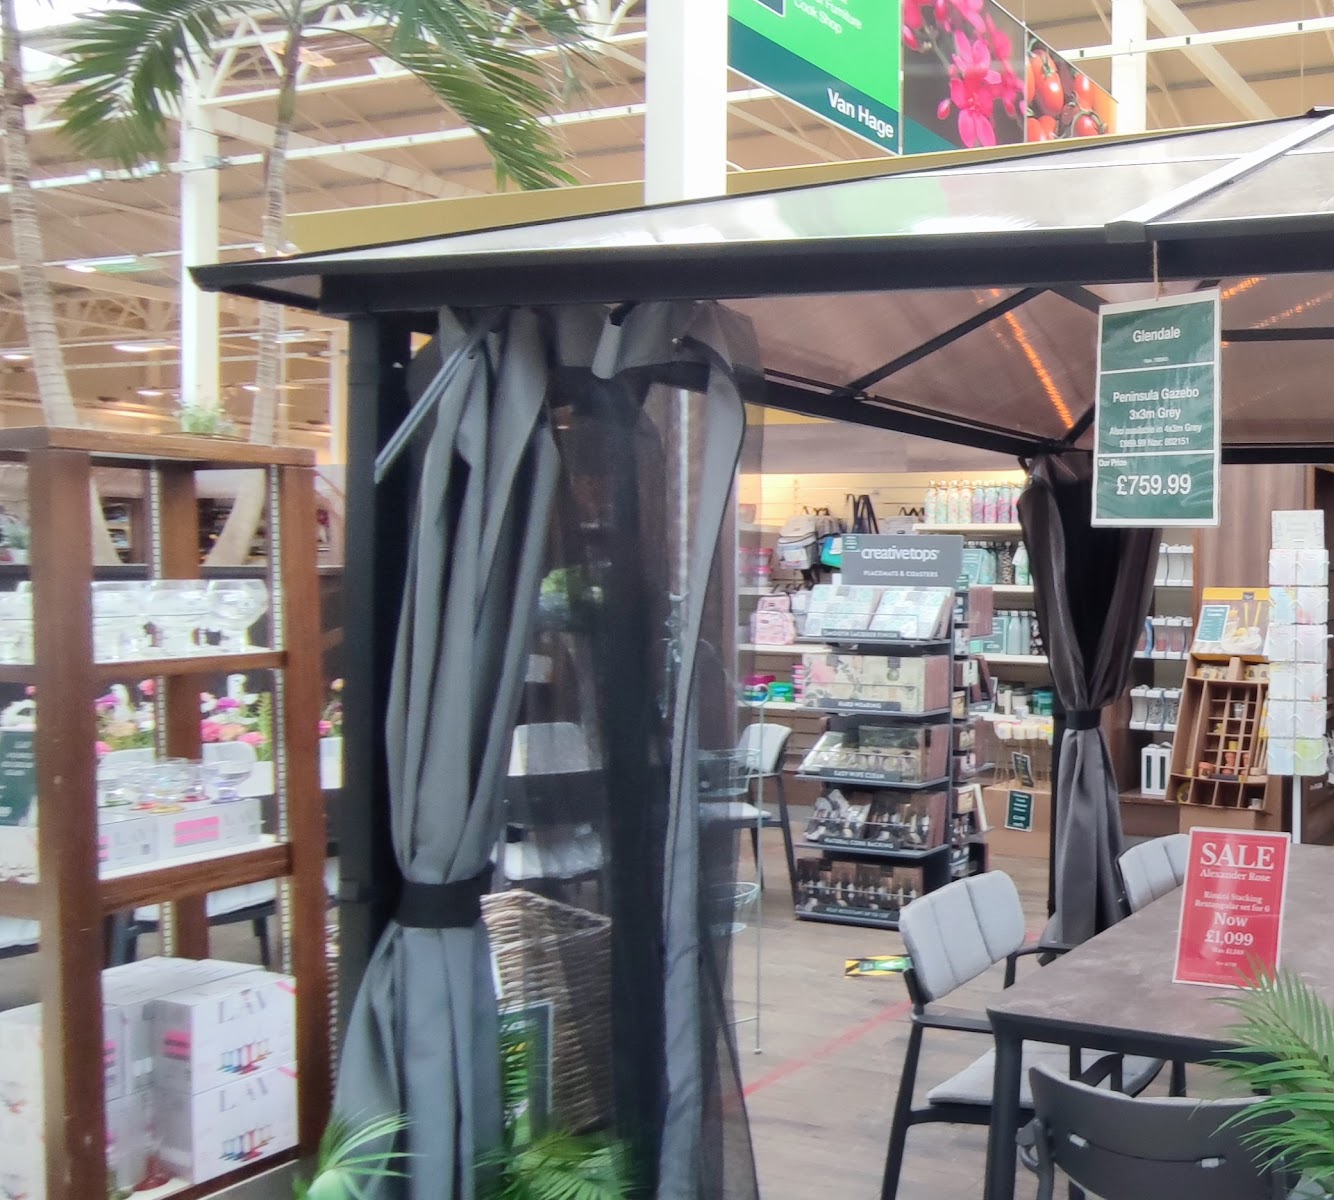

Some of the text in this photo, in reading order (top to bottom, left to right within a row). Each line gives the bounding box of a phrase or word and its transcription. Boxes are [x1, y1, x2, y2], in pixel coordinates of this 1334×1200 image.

[827, 87, 895, 138] Van Hage
[1132, 326, 1181, 343] Glendale
[1112, 386, 1200, 403] Peninsula Gazebo
[1128, 407, 1181, 420] 3x3m Grey
[1184, 423, 1203, 434] Grey
[1110, 458, 1128, 467] Price
[1116, 473, 1192, 496] £759.99
[861, 545, 939, 562] creativetops
[863, 569, 899, 577] PLACEMATS
[1200, 842, 1275, 870] SALE
[1199, 868, 1271, 882] Alexander Rose
[1230, 893, 1263, 904] Stacking
[1251, 904, 1263, 912] for
[1264, 905, 1271, 913] 6
[1214, 911, 1249, 927] Now
